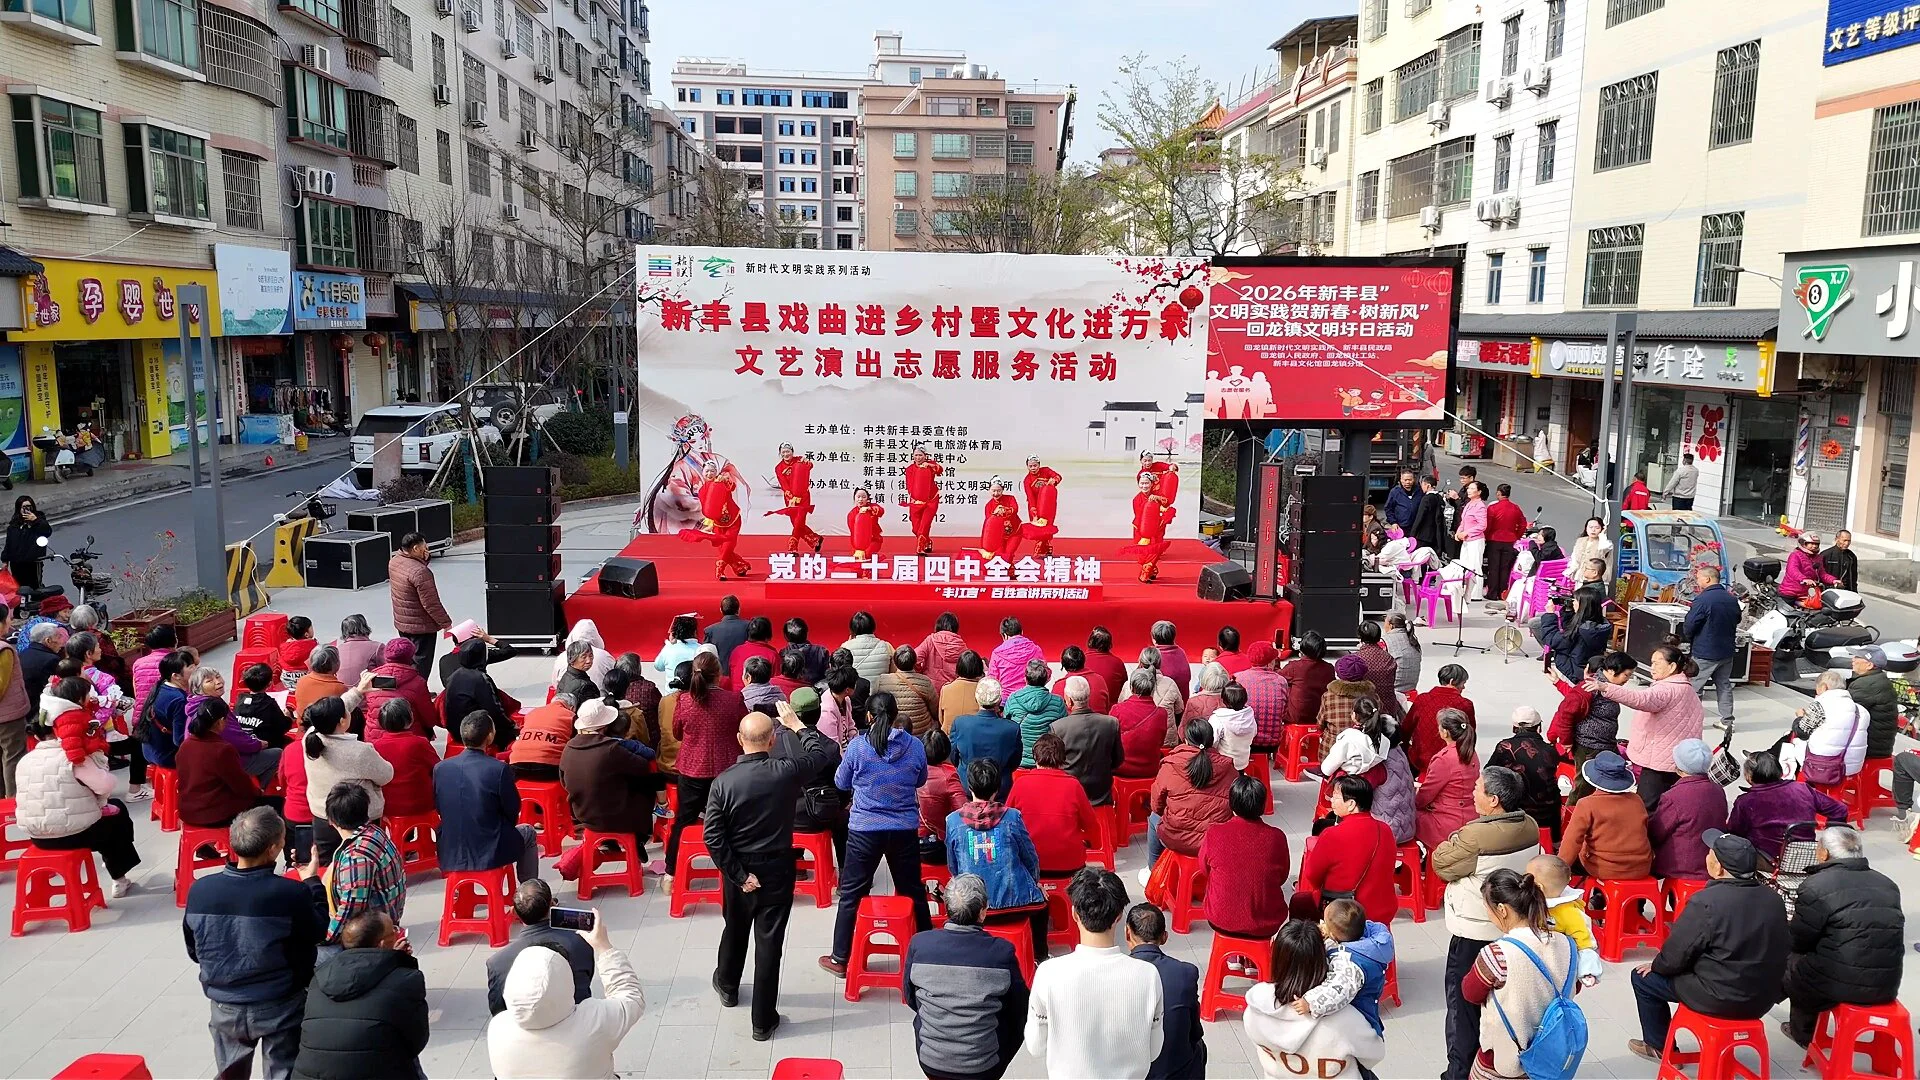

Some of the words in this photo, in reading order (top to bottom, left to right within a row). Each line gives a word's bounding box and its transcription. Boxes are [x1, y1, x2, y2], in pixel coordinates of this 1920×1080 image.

[745, 262, 872, 276] 新时代文明实践系列活动
[1829, 271, 1846, 285] XJ
[661, 299, 1188, 340] 新丰县戏曲进乡村暨文化进万家
[735, 346, 1118, 381] 文艺演出志愿服务活动
[768, 553, 1101, 583] 党的二十届四中全会精神
